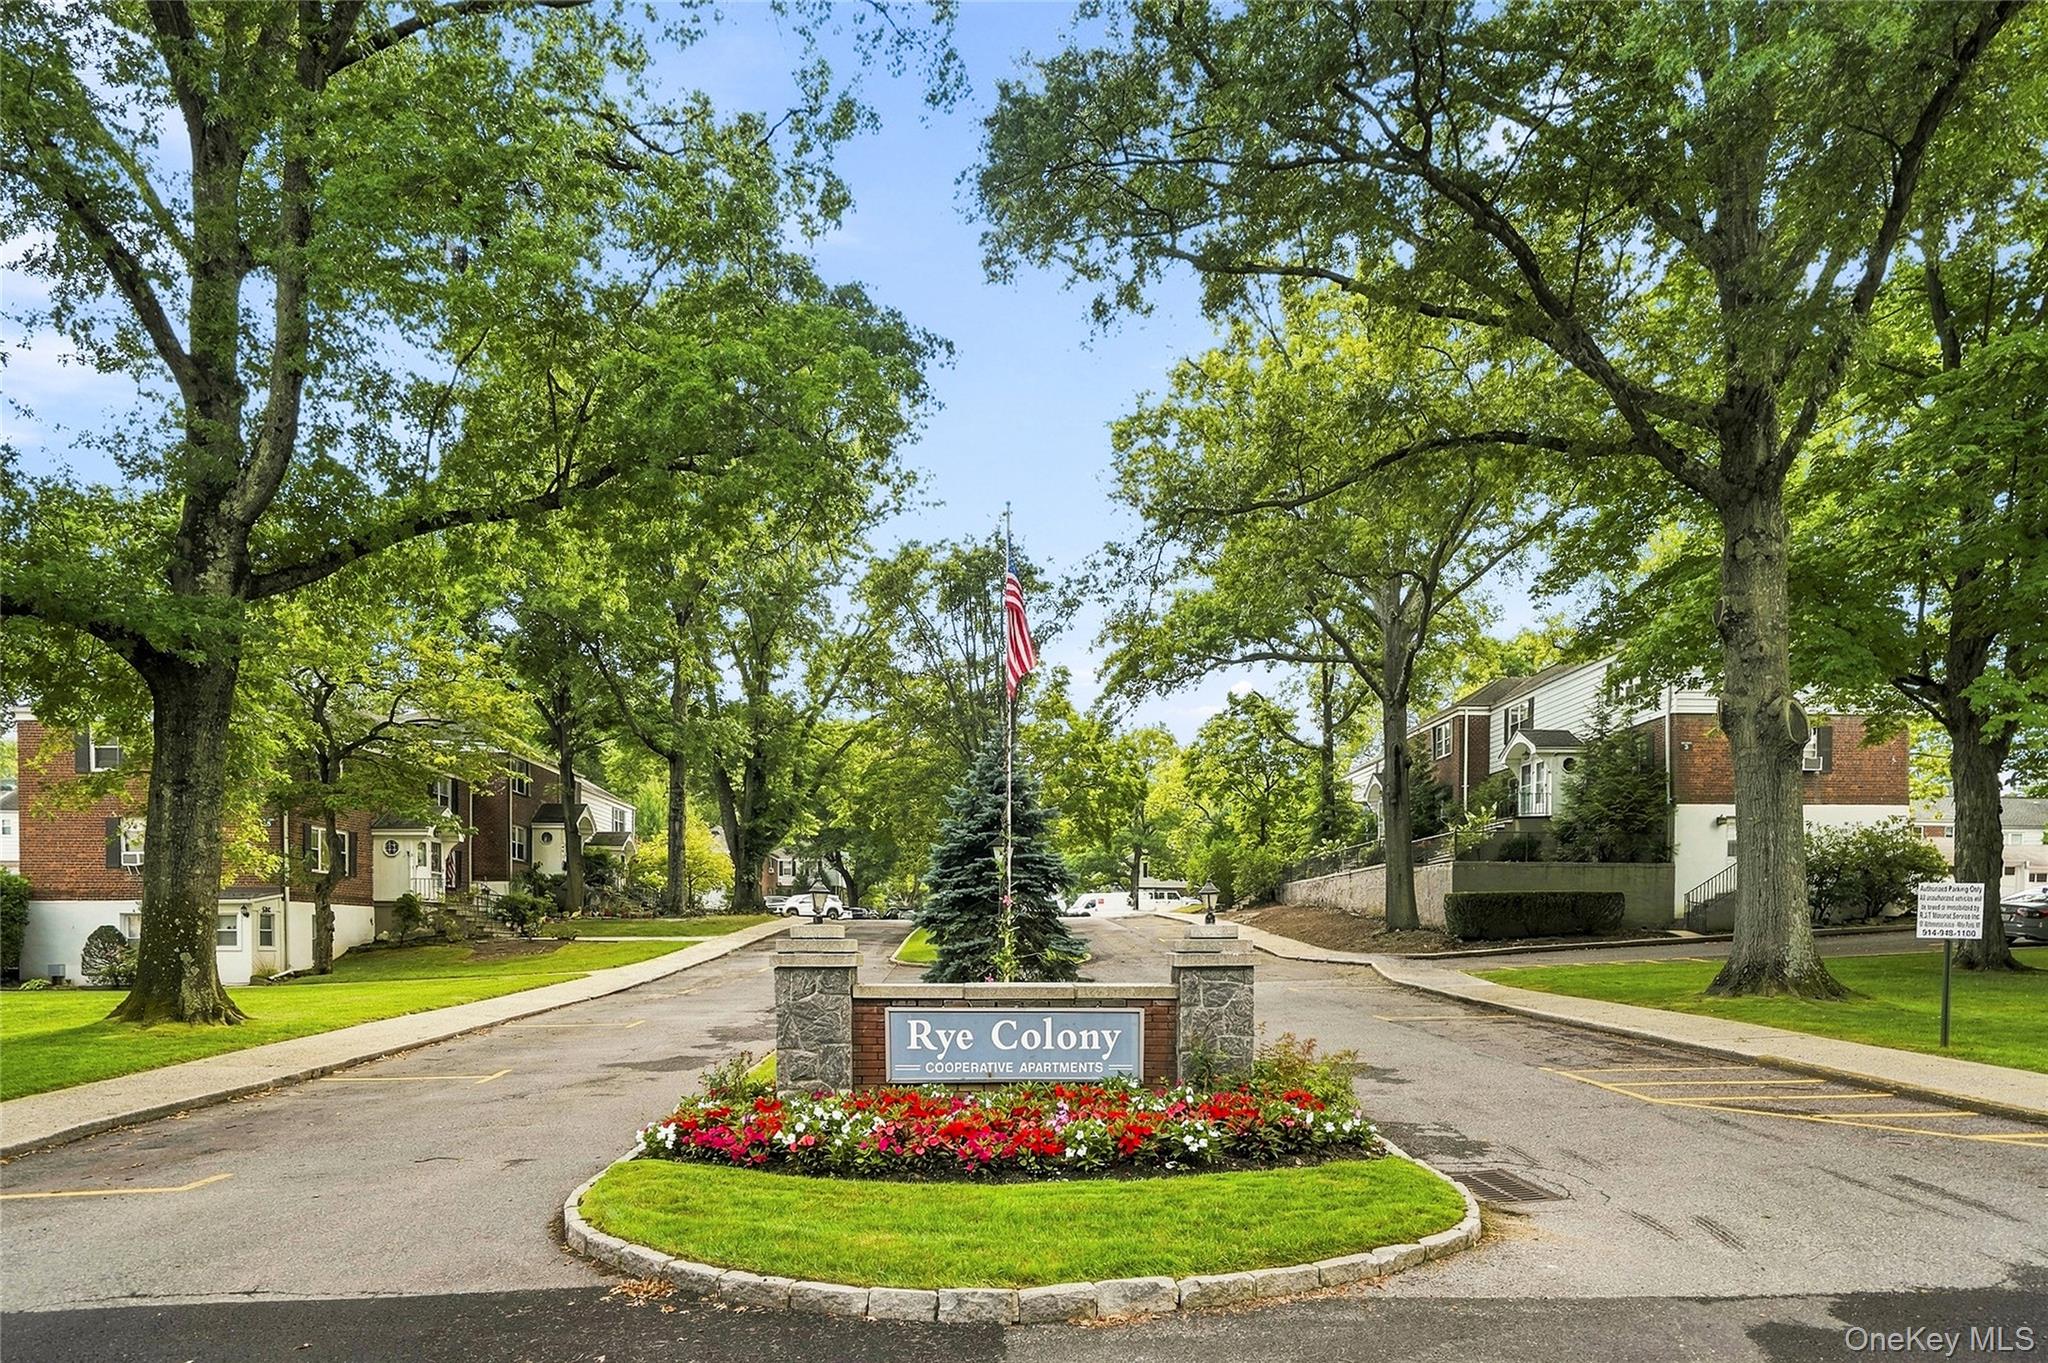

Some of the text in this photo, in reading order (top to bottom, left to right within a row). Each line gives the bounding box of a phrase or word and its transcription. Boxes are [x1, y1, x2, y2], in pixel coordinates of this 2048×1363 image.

[1948, 885, 1968, 893] Parking
[1969, 885, 1982, 893] Only
[906, 1017, 1122, 1060] Rye Colony
[925, 1061, 1104, 1074] COOPERATIVE APARTMENTS
